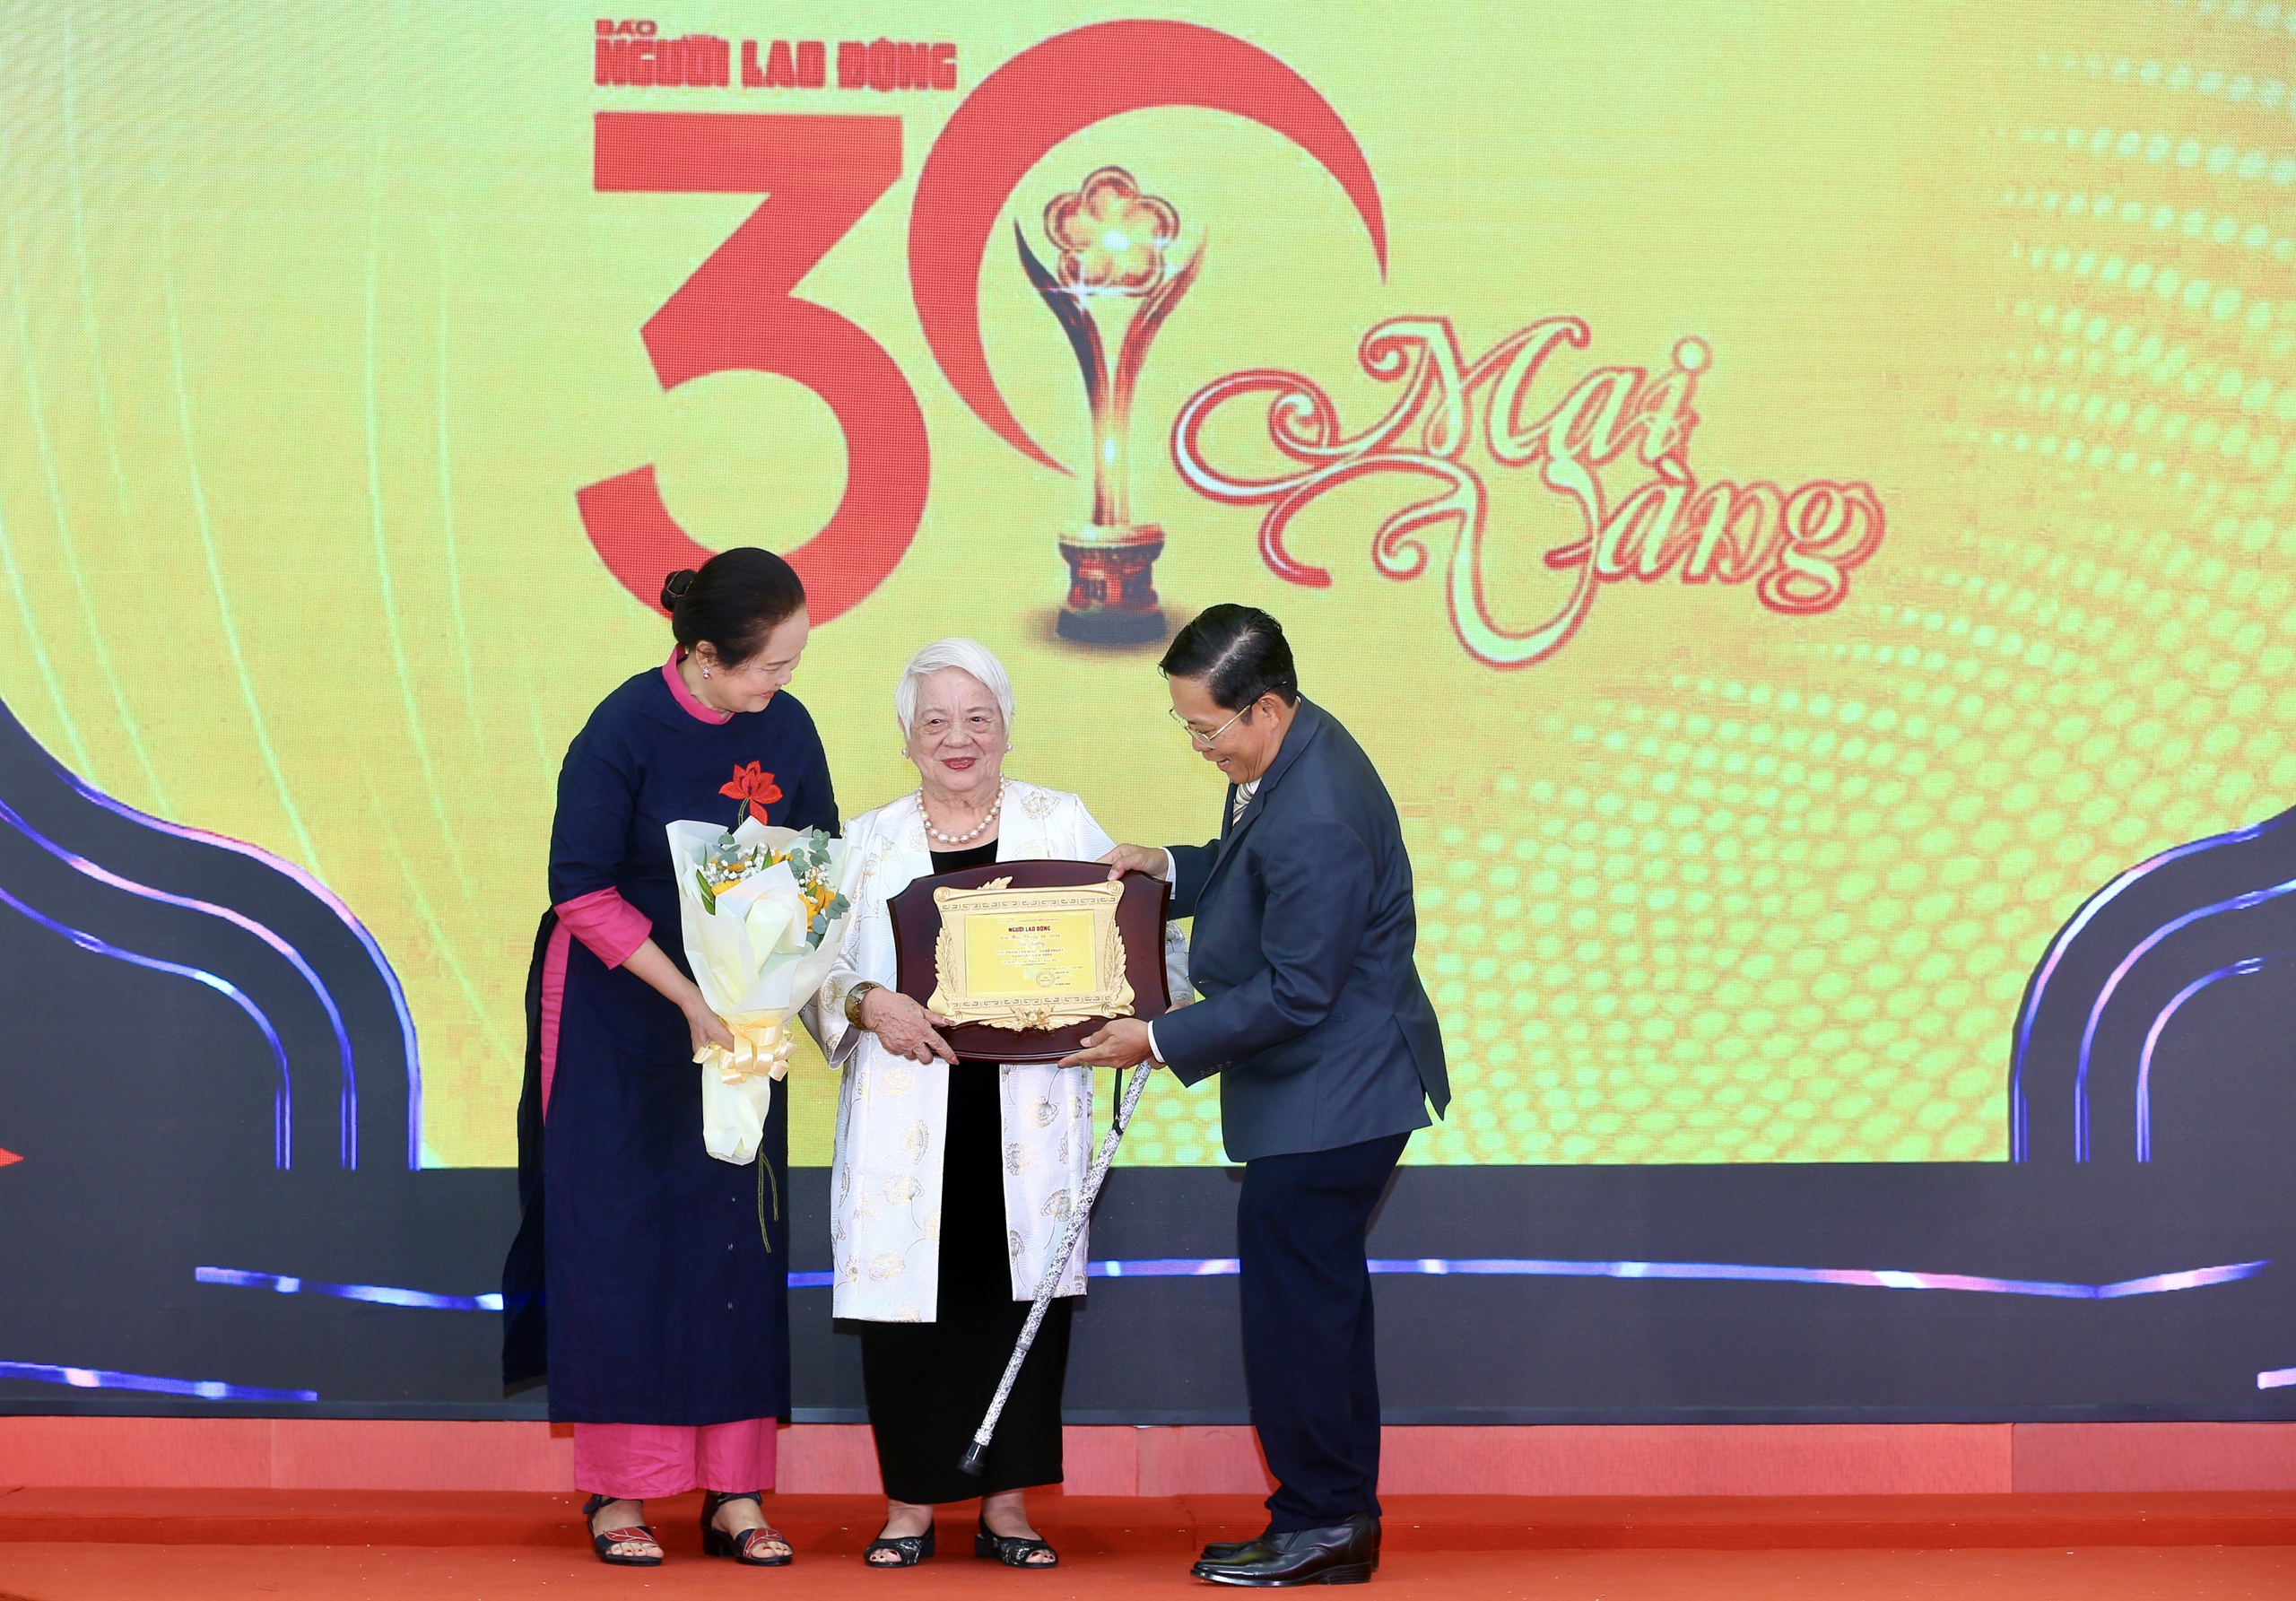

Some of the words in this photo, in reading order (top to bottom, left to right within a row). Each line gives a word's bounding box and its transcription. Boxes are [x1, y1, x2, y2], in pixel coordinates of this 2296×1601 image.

[742, 39, 826, 88] LAO
[576, 19, 1387, 630] 30
[1269, 317, 1711, 467] Mai
